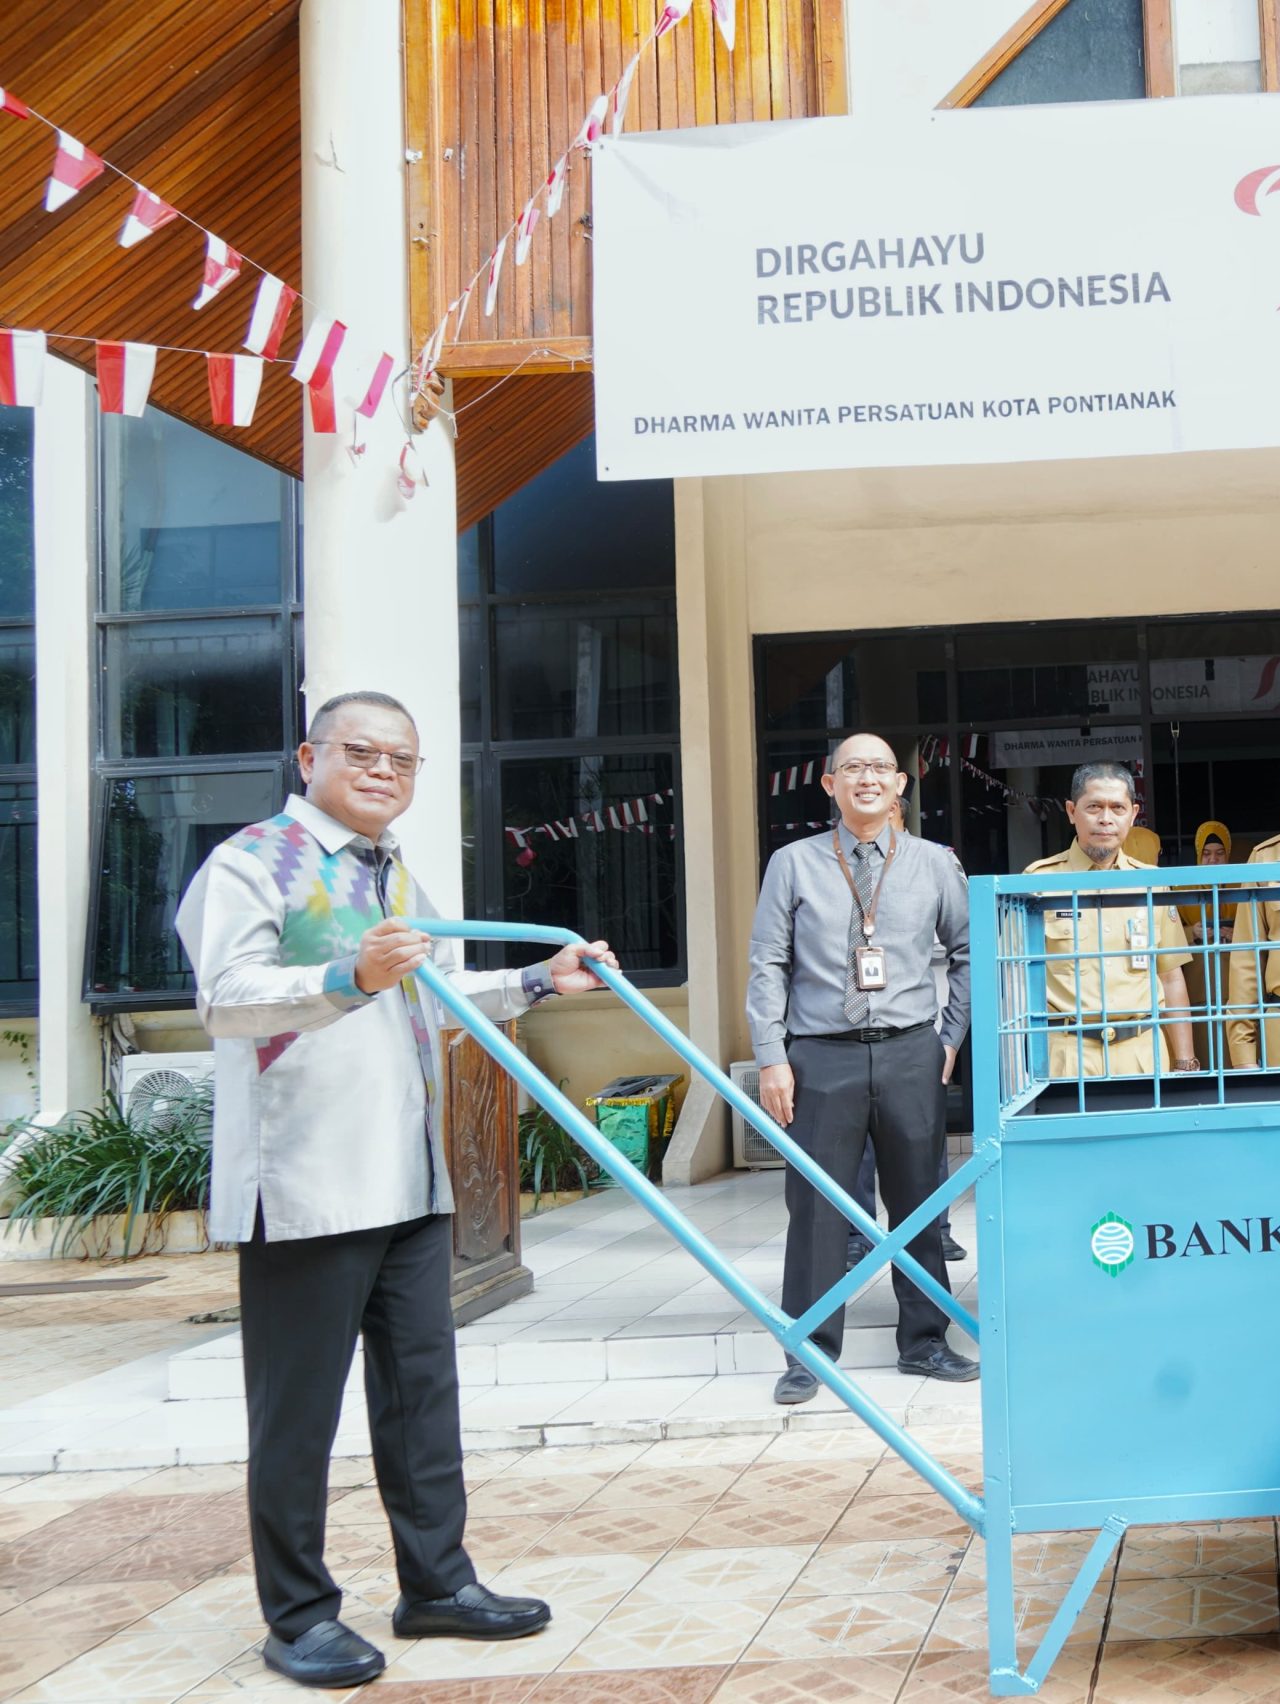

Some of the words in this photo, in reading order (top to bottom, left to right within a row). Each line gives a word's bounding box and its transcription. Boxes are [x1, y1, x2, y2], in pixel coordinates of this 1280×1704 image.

[755, 231, 985, 278] DIRGAHAYU
[756, 283, 945, 325] REPUBLIK
[954, 271, 1172, 313] INDONESIA
[634, 412, 736, 435] DHARMA
[742, 406, 831, 429] WANITA
[838, 400, 975, 424] PERSATUAN
[982, 397, 1041, 419] KOTA
[1048, 389, 1177, 414] PONTIANAK
[1004, 740, 1045, 750] DHARMA
[1048, 738, 1081, 748] WANITA
[1083, 735, 1137, 746] PERSATUAN
